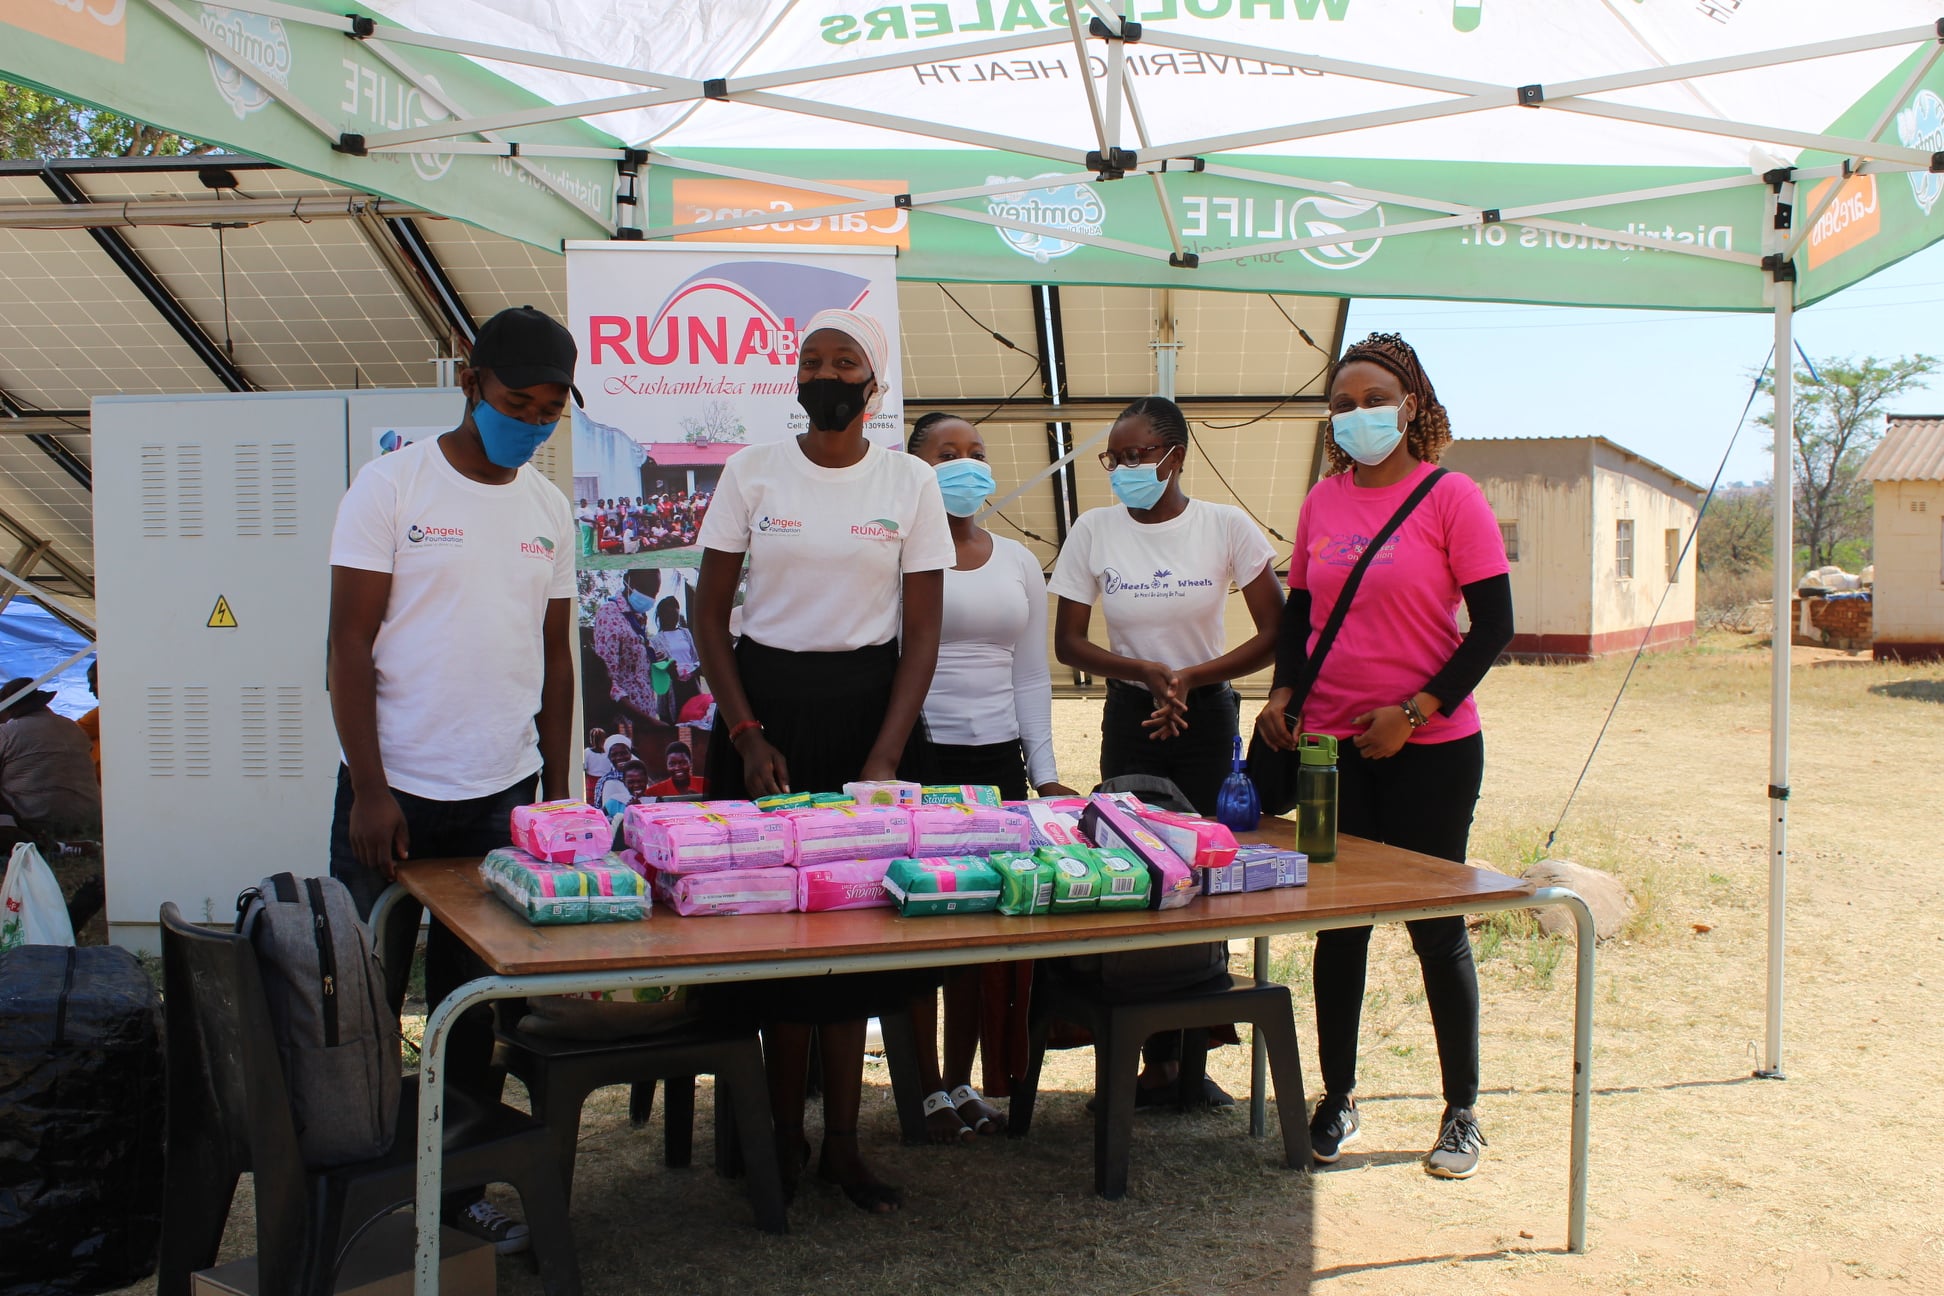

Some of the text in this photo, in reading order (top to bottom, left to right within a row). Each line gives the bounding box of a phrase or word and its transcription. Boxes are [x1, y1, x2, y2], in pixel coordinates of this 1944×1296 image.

[603, 375, 800, 396] Kushambidza munh
[771, 518, 802, 528] Angels
[425, 526, 464, 537] Angels
[1120, 582, 1150, 590] Heels
[1178, 578, 1213, 588] Wheels
[922, 794, 957, 805] Stayfree
[844, 884, 886, 901] always
